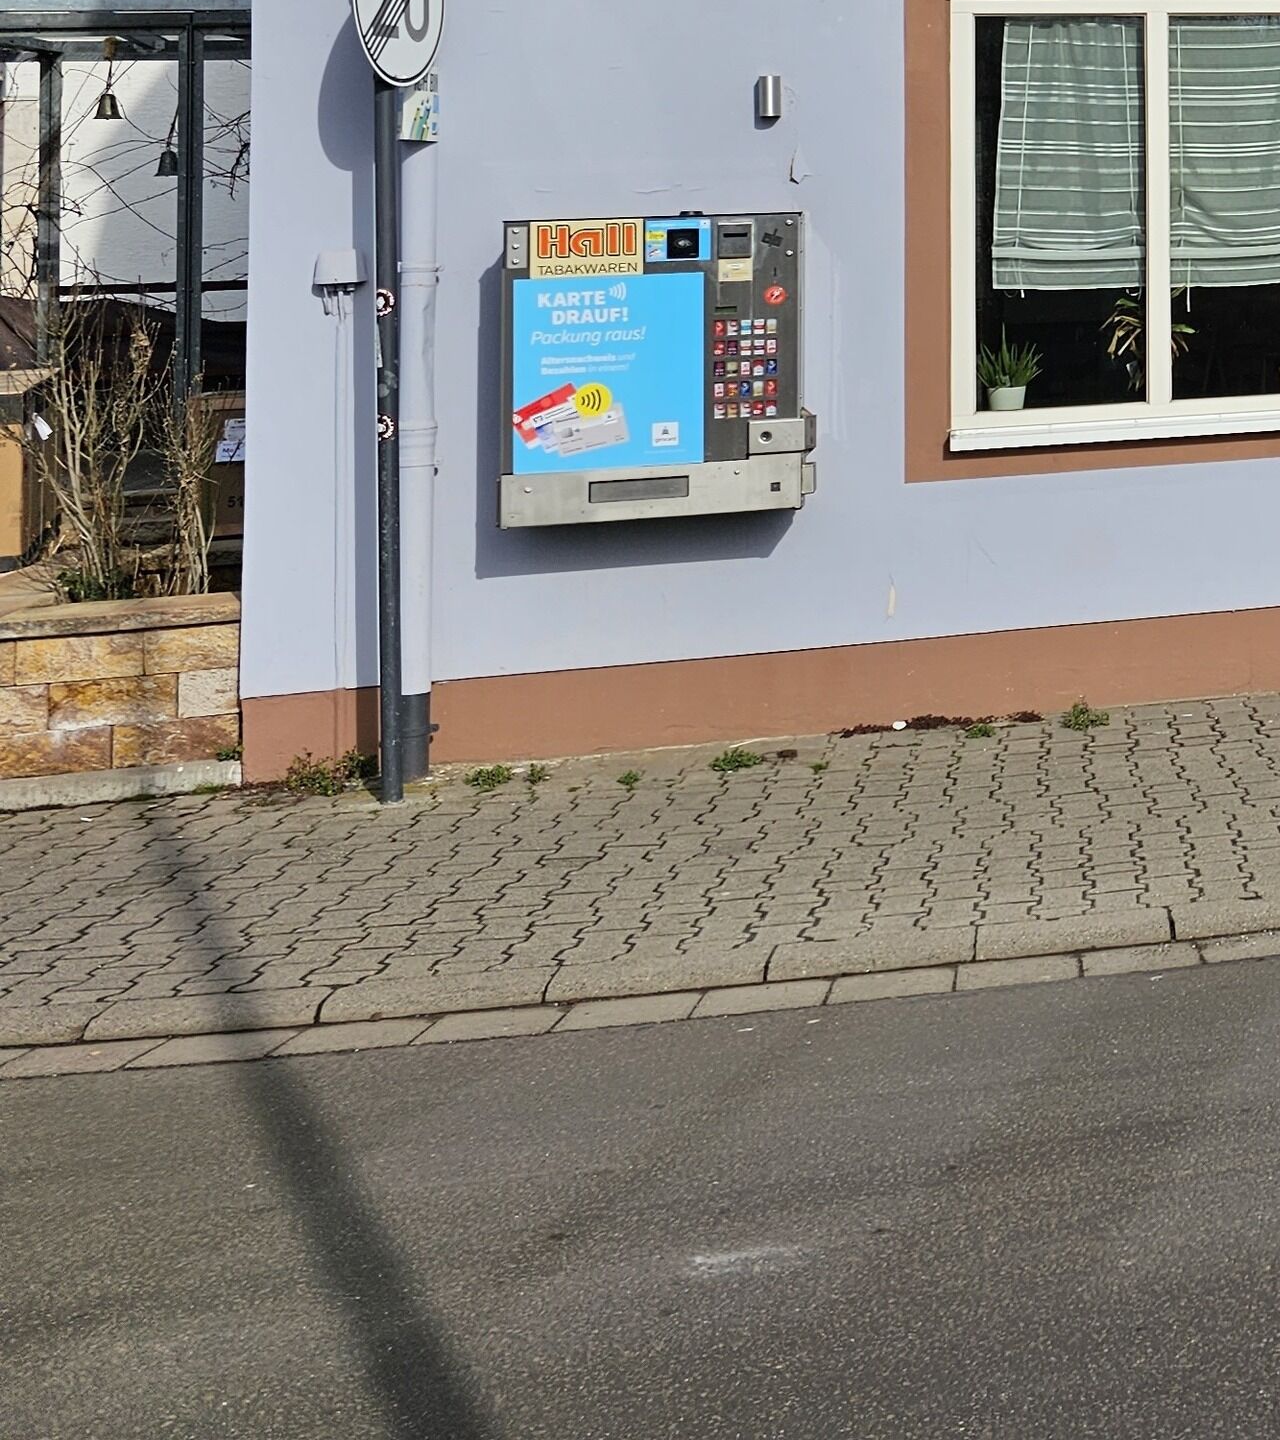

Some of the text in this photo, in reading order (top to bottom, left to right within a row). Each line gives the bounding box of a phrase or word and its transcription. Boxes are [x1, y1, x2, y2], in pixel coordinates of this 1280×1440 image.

[537, 223, 637, 258] Hall
[537, 262, 638, 276] TABAKWAREN
[537, 290, 607, 308] KARTE
[552, 307, 629, 325] DRAUF!
[530, 326, 647, 346] Packung raus!
